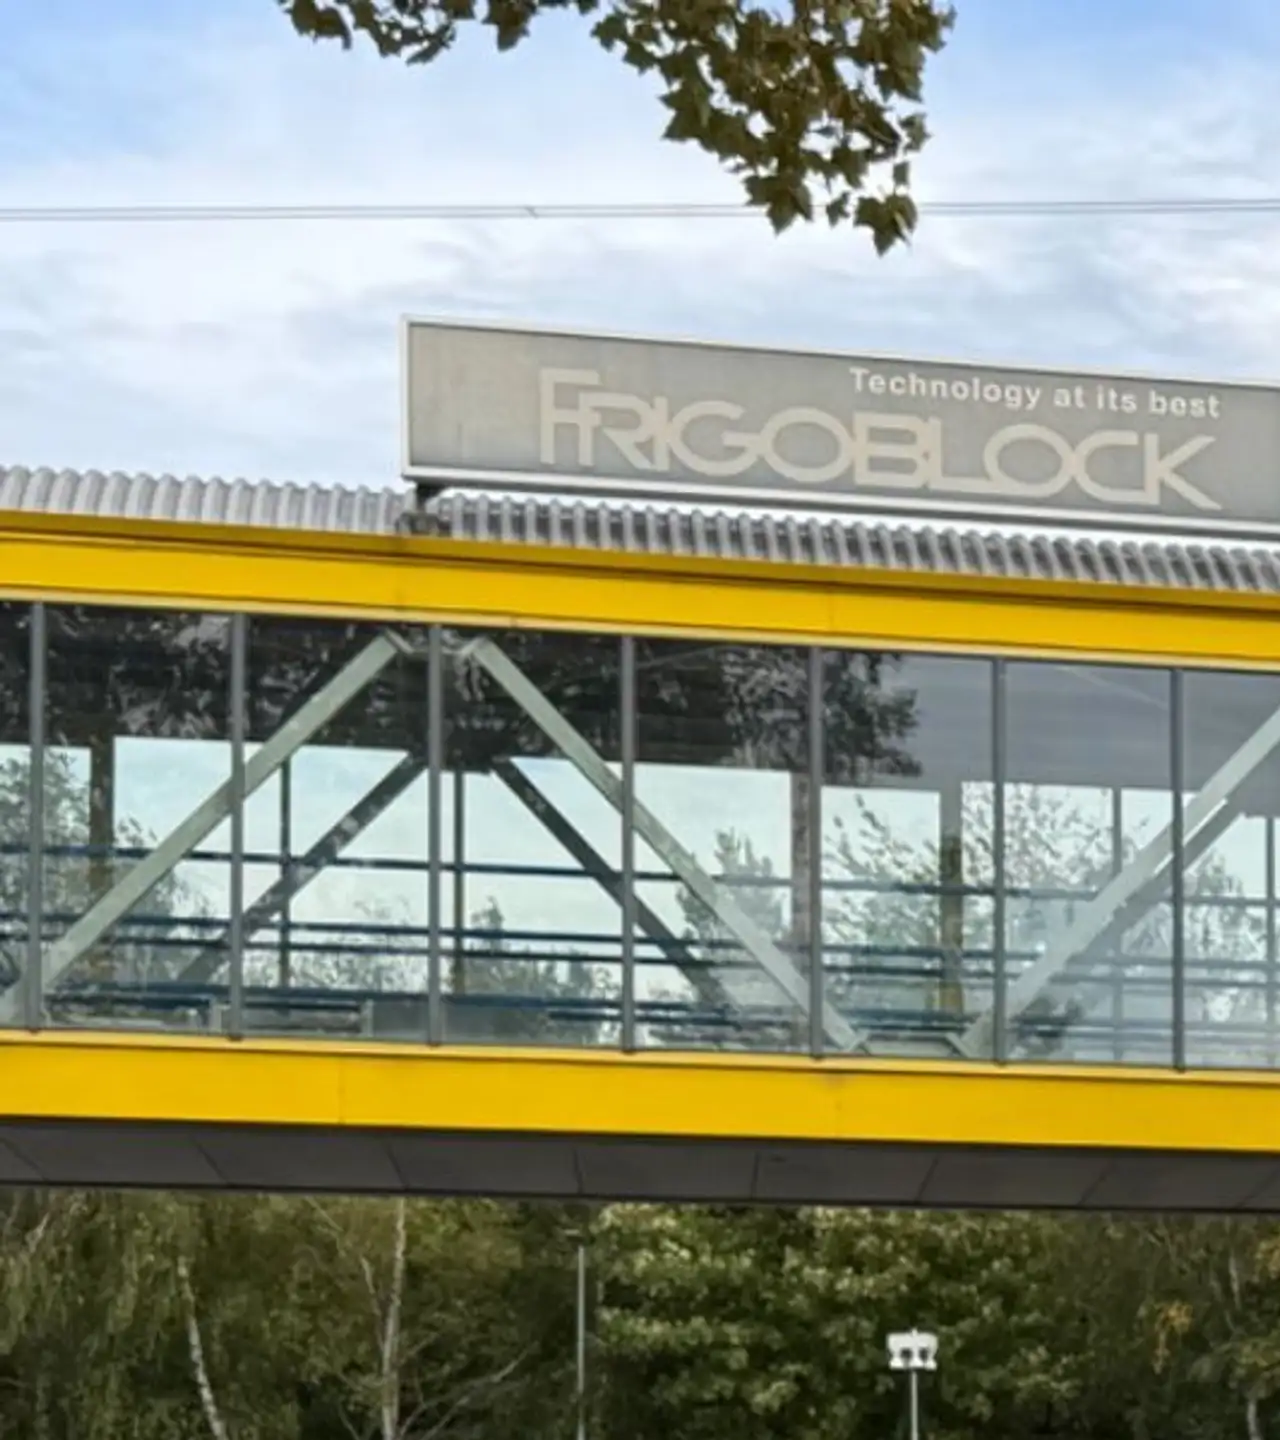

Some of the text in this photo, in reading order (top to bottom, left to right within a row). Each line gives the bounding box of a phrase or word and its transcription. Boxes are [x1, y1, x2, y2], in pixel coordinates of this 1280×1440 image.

[538, 366, 1223, 511] FRIGOBLOCK
[849, 366, 1220, 419] Technology at its best
